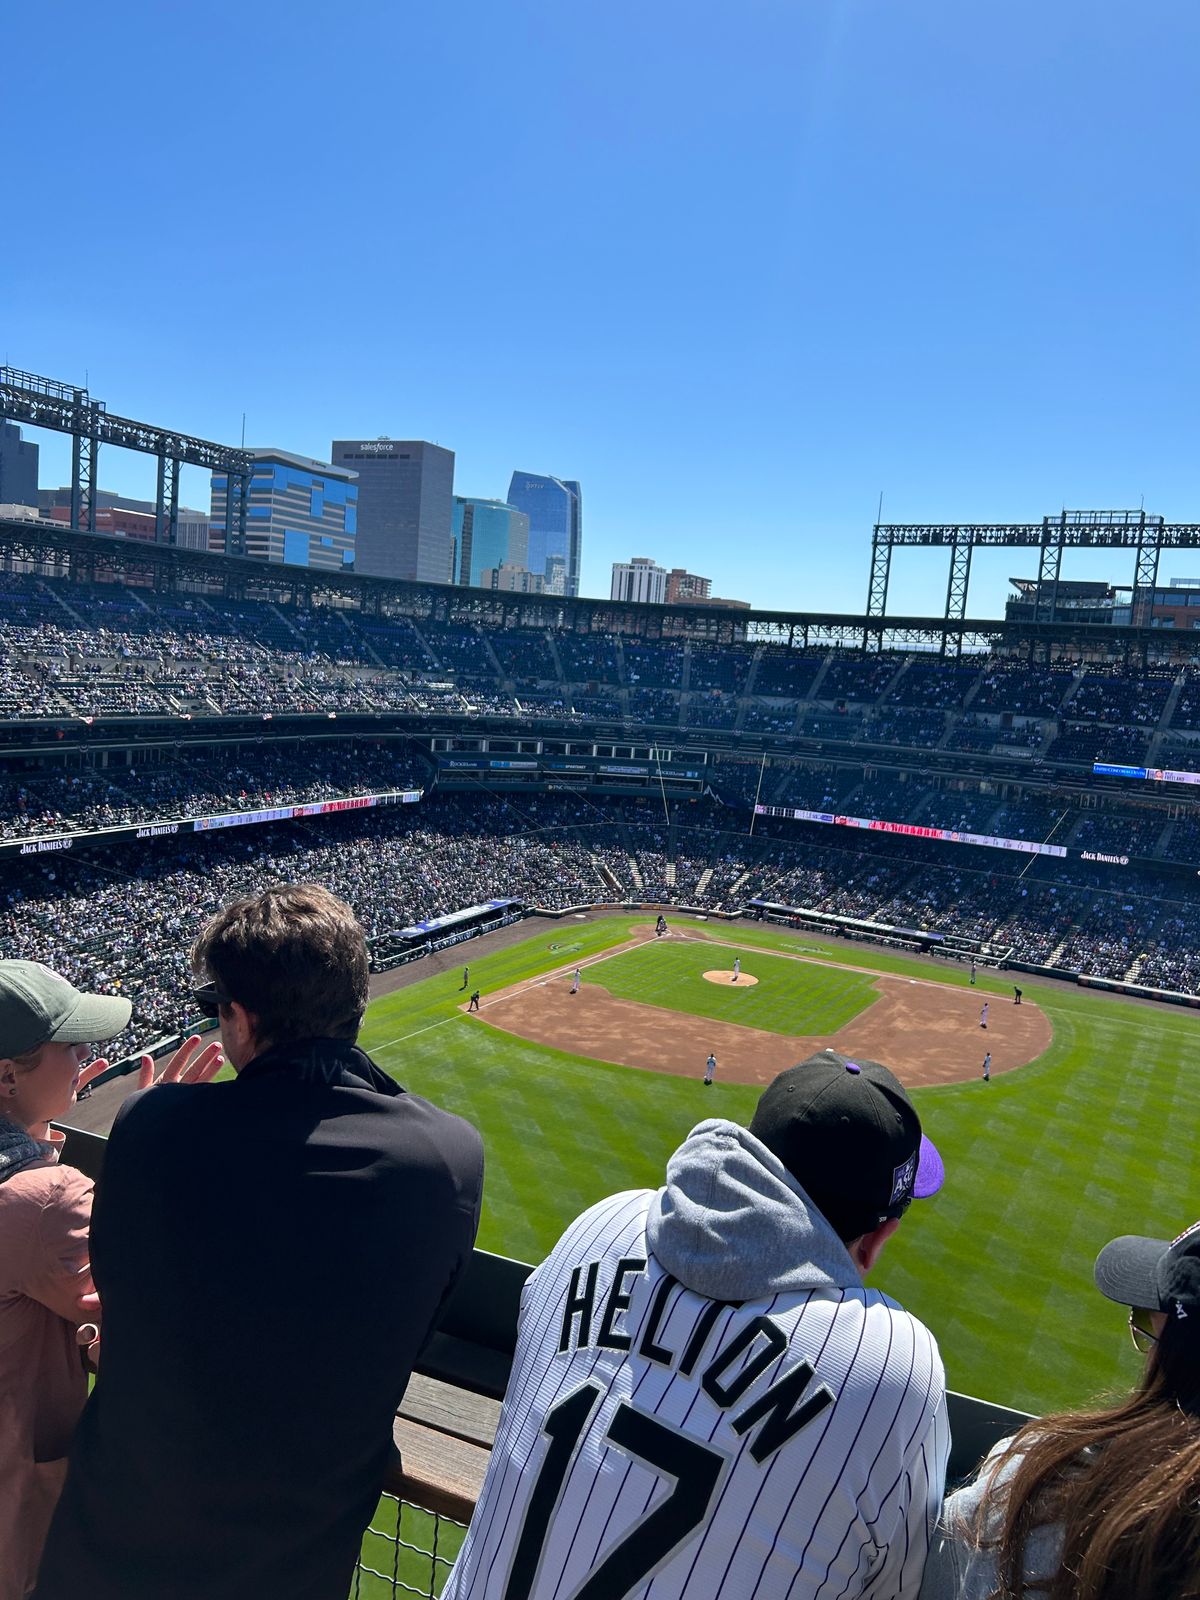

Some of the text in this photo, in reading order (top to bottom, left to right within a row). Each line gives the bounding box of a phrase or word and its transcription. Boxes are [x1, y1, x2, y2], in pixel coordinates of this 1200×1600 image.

[360, 443, 394, 452] salesforce
[136, 828, 150, 838] JACK
[20, 843, 37, 854] JACK
[1080, 851, 1096, 860] JACK
[498, 1378, 732, 1600] 17
